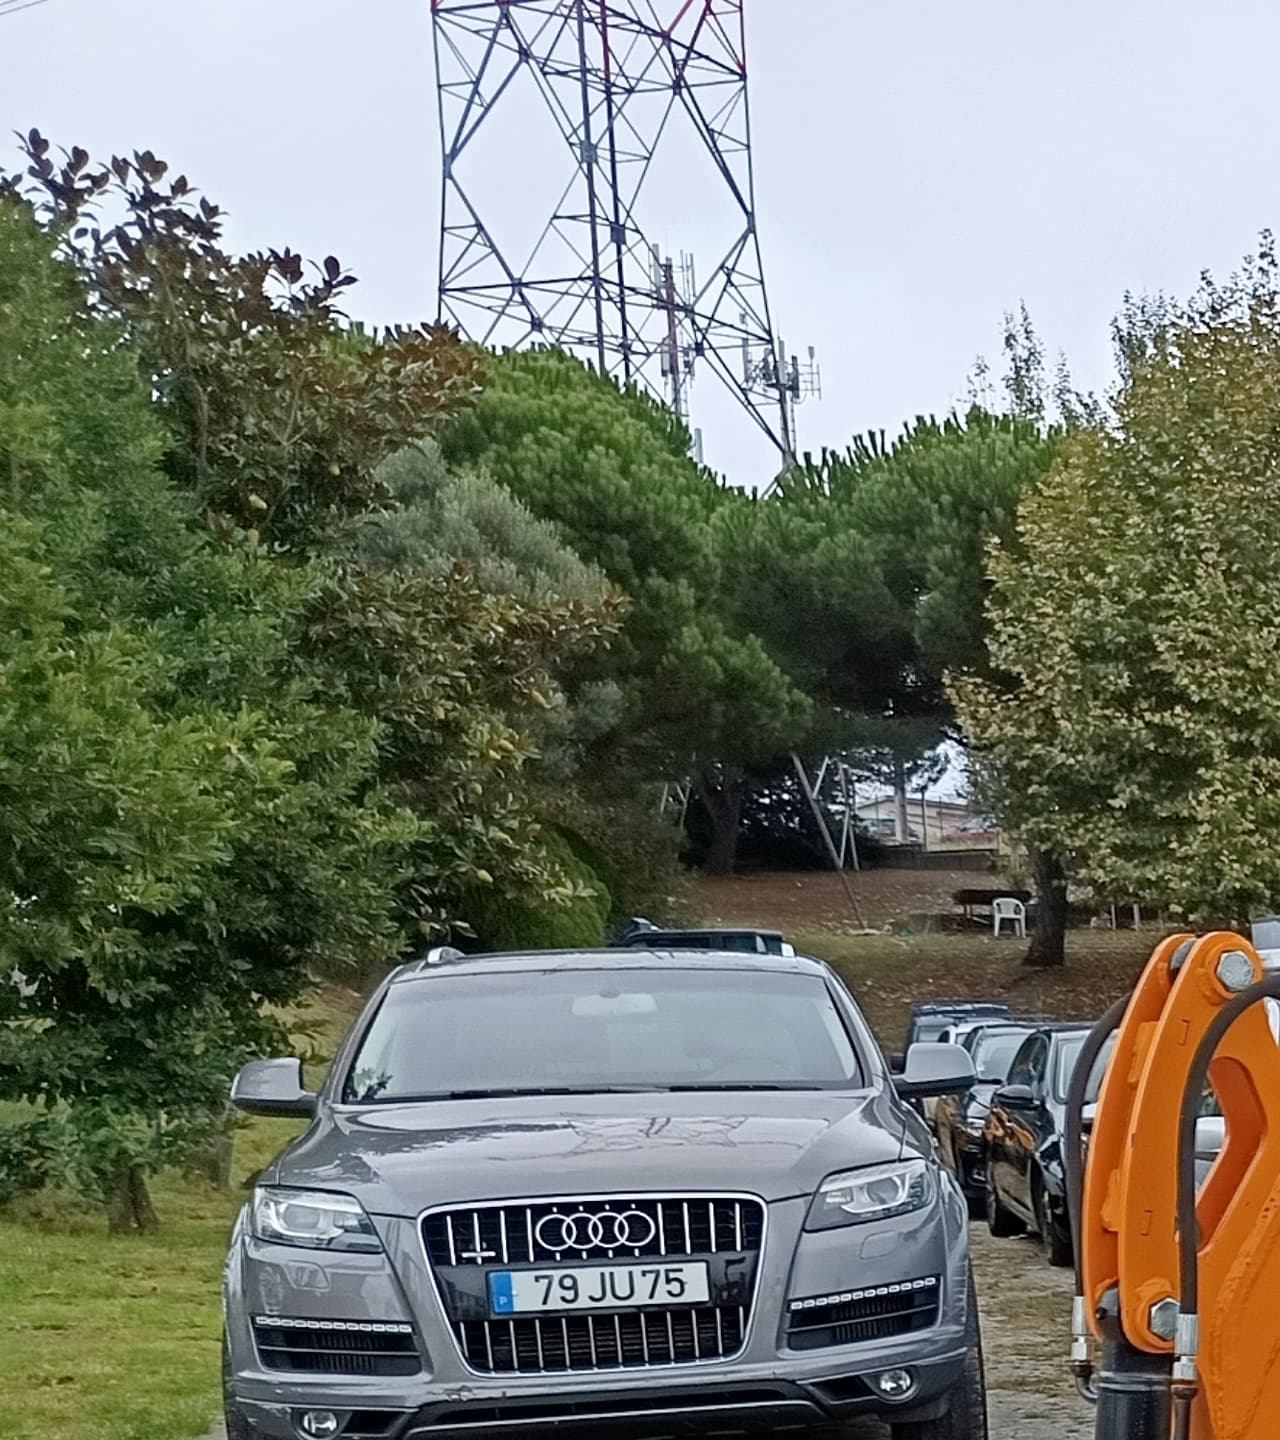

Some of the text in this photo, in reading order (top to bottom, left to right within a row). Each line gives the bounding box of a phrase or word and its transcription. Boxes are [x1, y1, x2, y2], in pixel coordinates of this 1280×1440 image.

[534, 1268, 686, 1306] 79 JU 75
